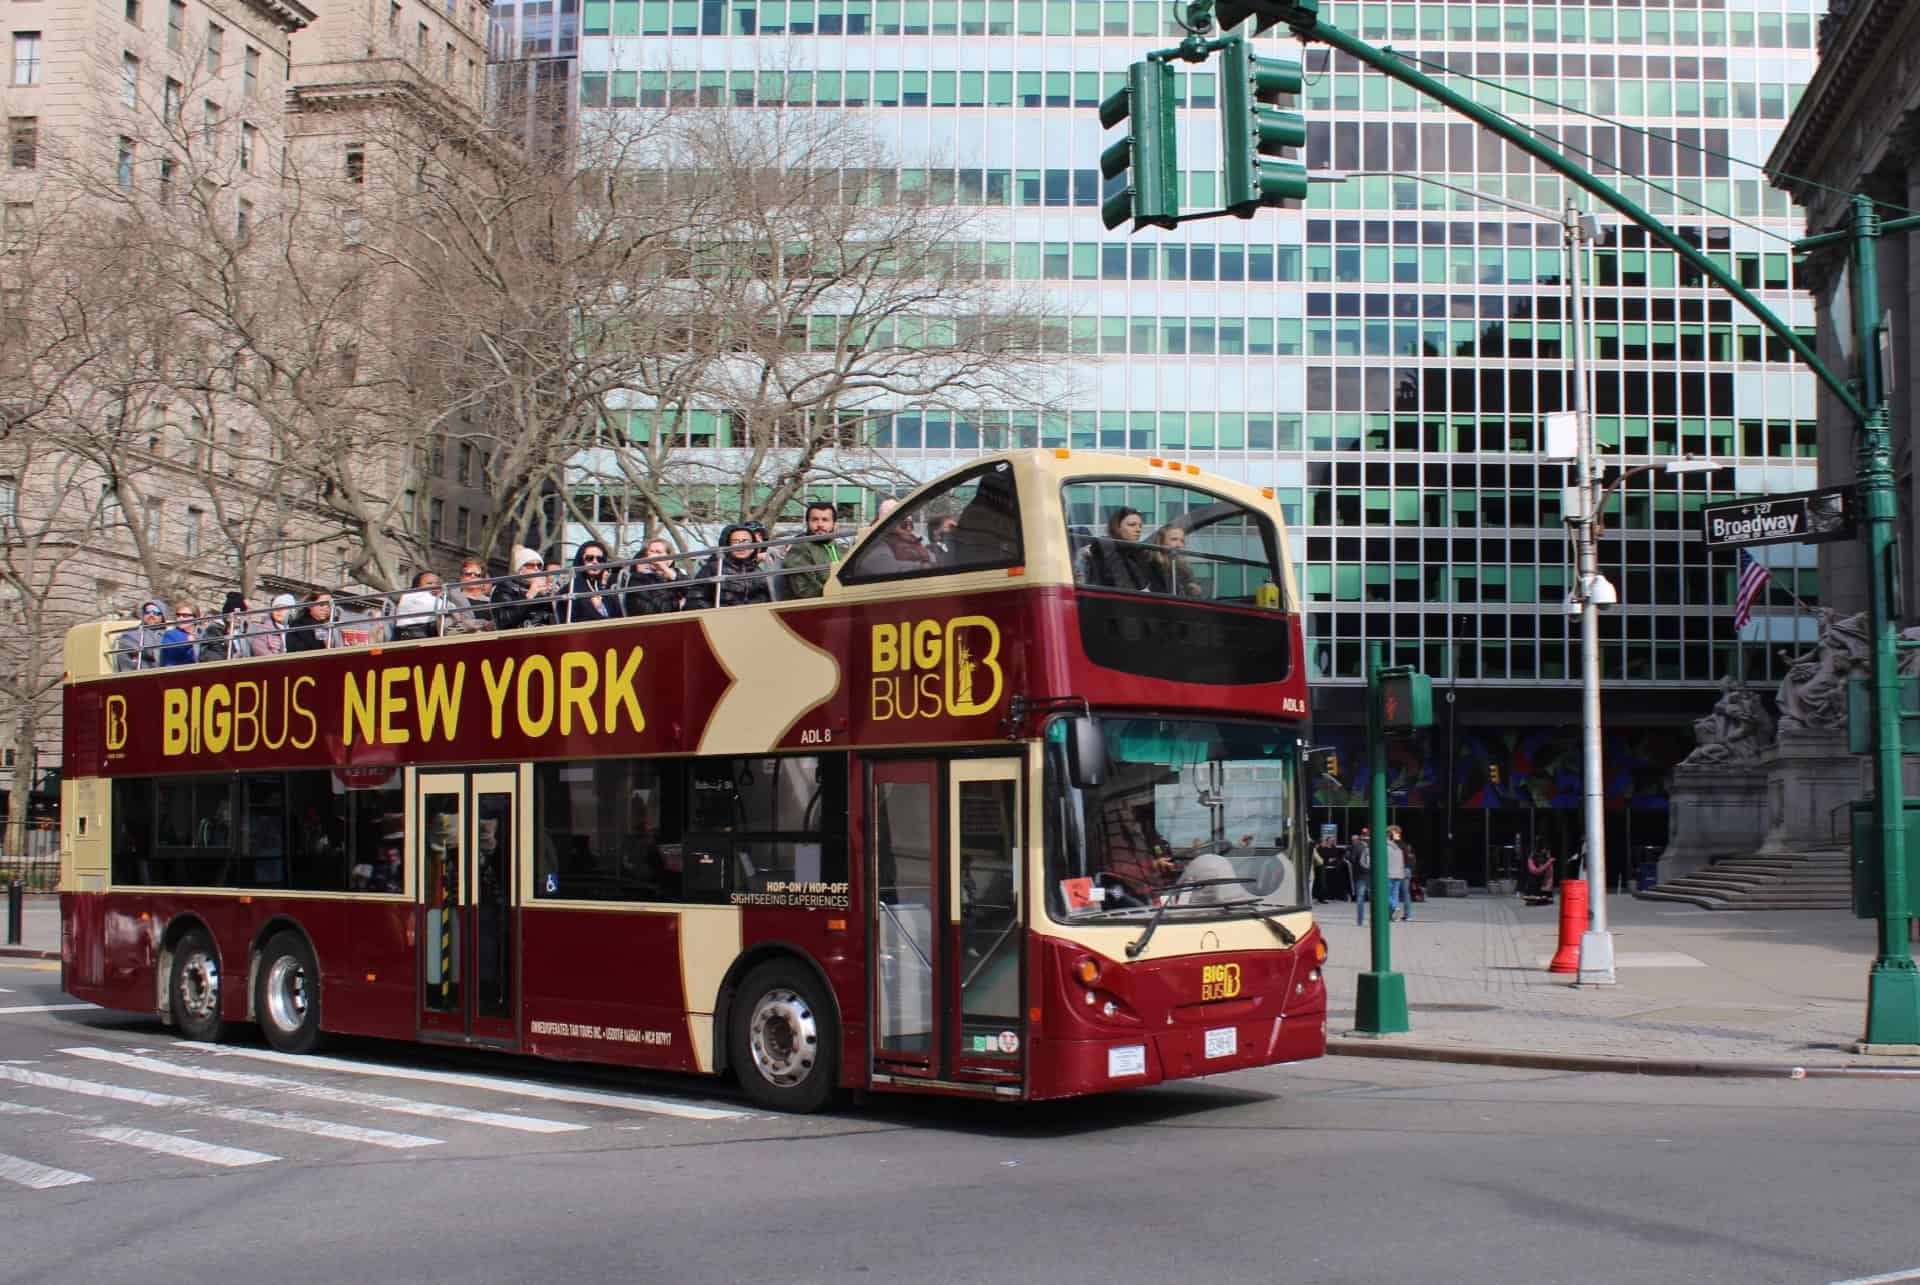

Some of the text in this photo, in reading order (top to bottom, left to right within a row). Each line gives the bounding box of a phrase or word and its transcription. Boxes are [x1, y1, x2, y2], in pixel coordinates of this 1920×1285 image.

[1713, 513, 1799, 537] Broadway
[872, 618, 942, 673] BIG
[343, 661, 466, 747] NEW
[480, 645, 646, 740] YORK
[872, 673, 942, 721] BUS
[800, 728, 832, 744] ADL 8
[766, 881, 800, 892] HOP-ON
[809, 882, 849, 893] HOP-OFF
[730, 893, 849, 907] SIGHTSEEING EXPERIENCES
[1203, 964, 1224, 983] BIG
[1202, 983, 1224, 1001] BUS
